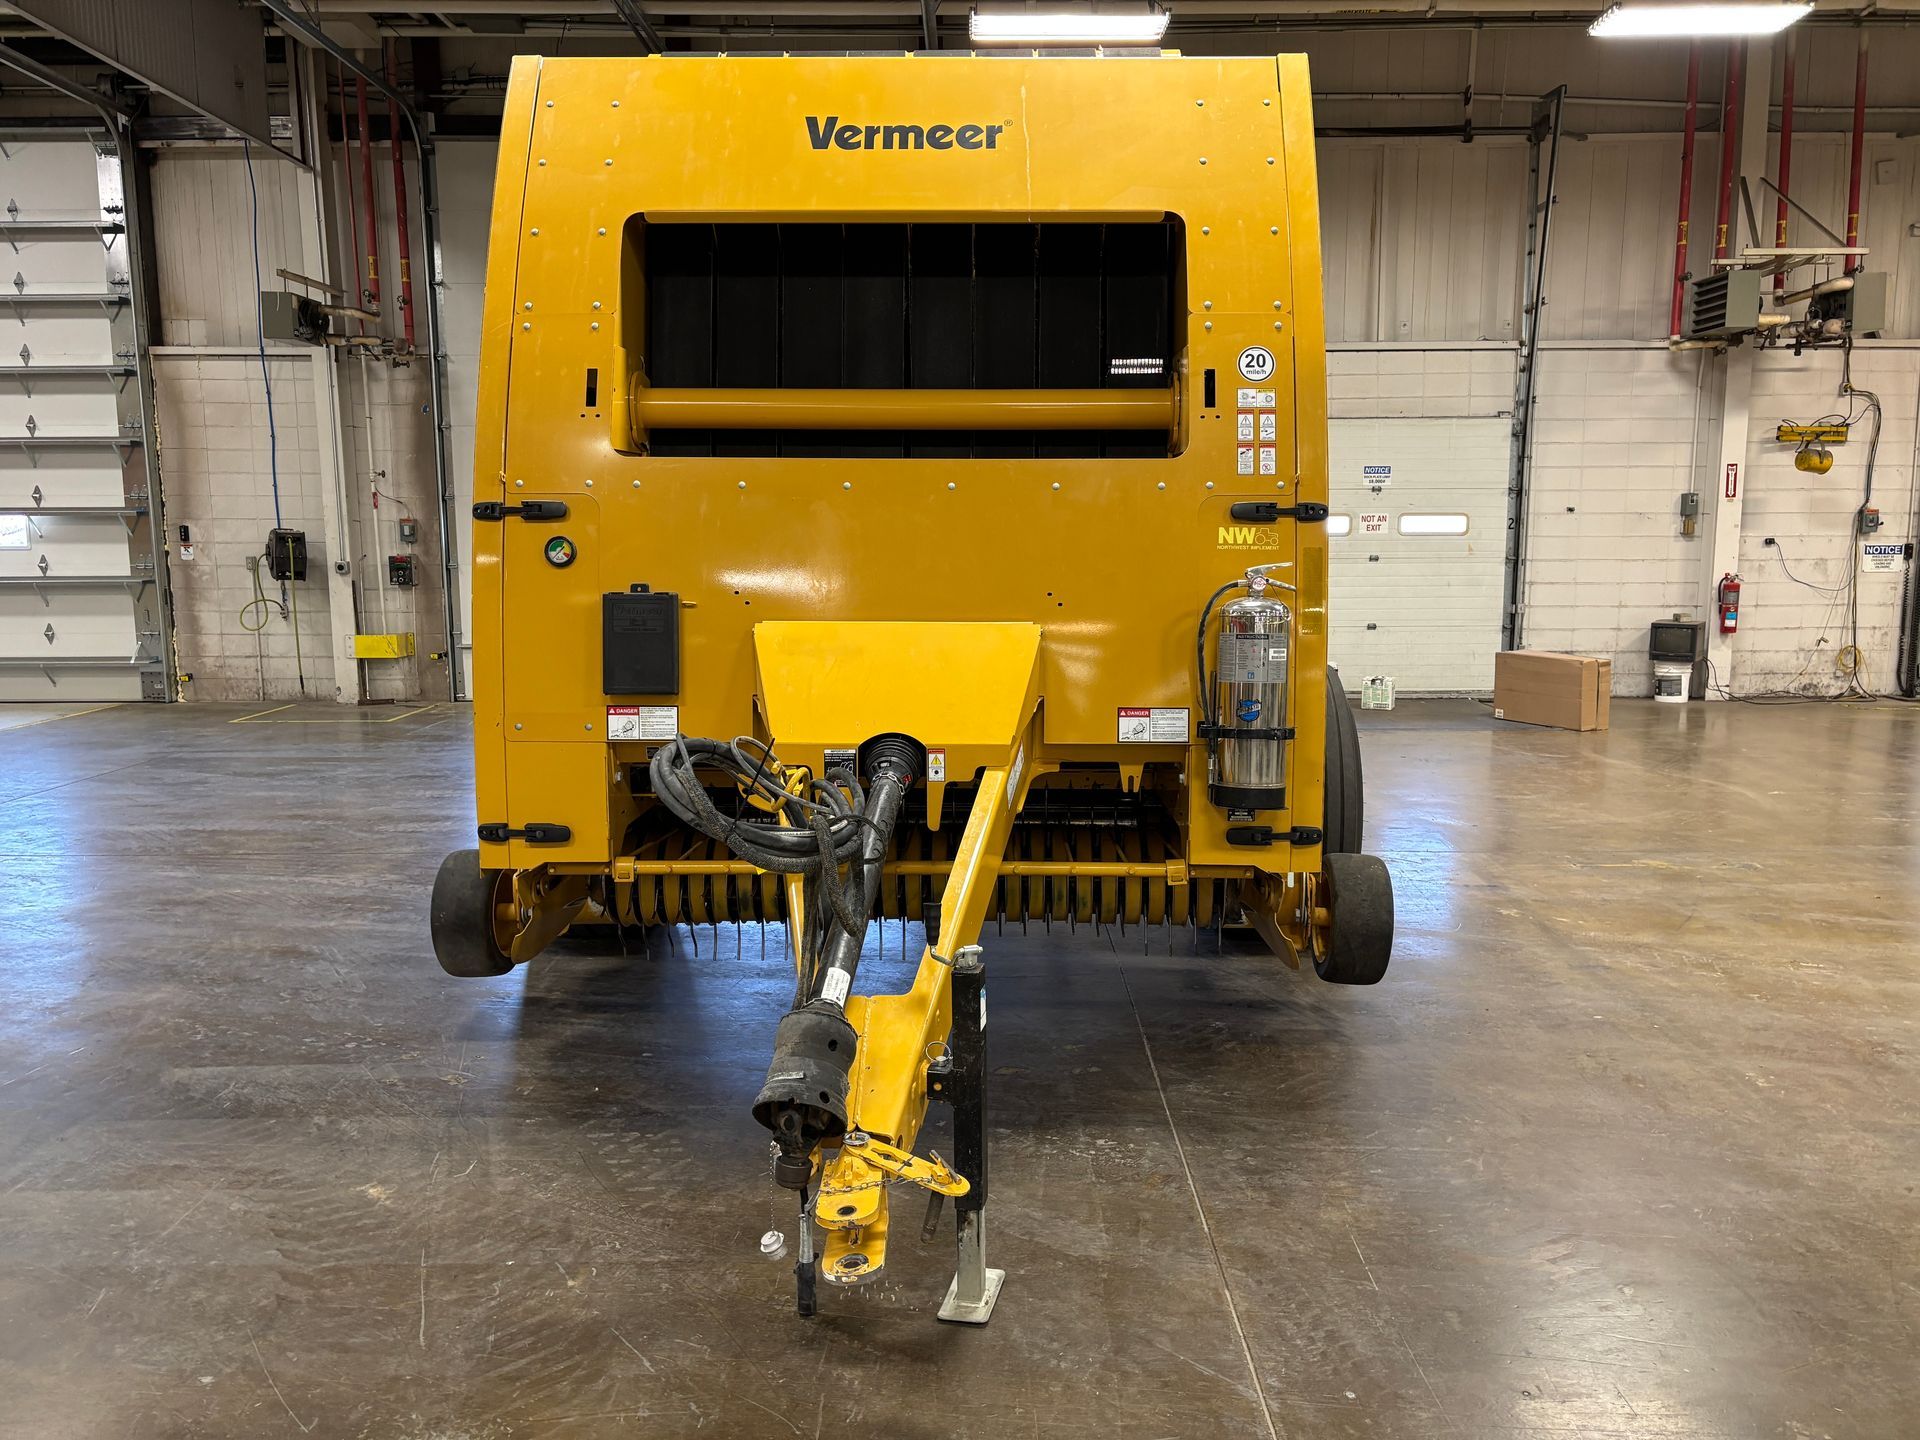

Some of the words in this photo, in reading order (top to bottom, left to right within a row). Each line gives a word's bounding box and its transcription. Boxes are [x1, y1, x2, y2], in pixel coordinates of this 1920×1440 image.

[1245, 353, 1266, 368] 20
[1508, 517, 1515, 530] 2
[1218, 527, 1256, 544] NW
[1866, 546, 1901, 554] NOTICE
